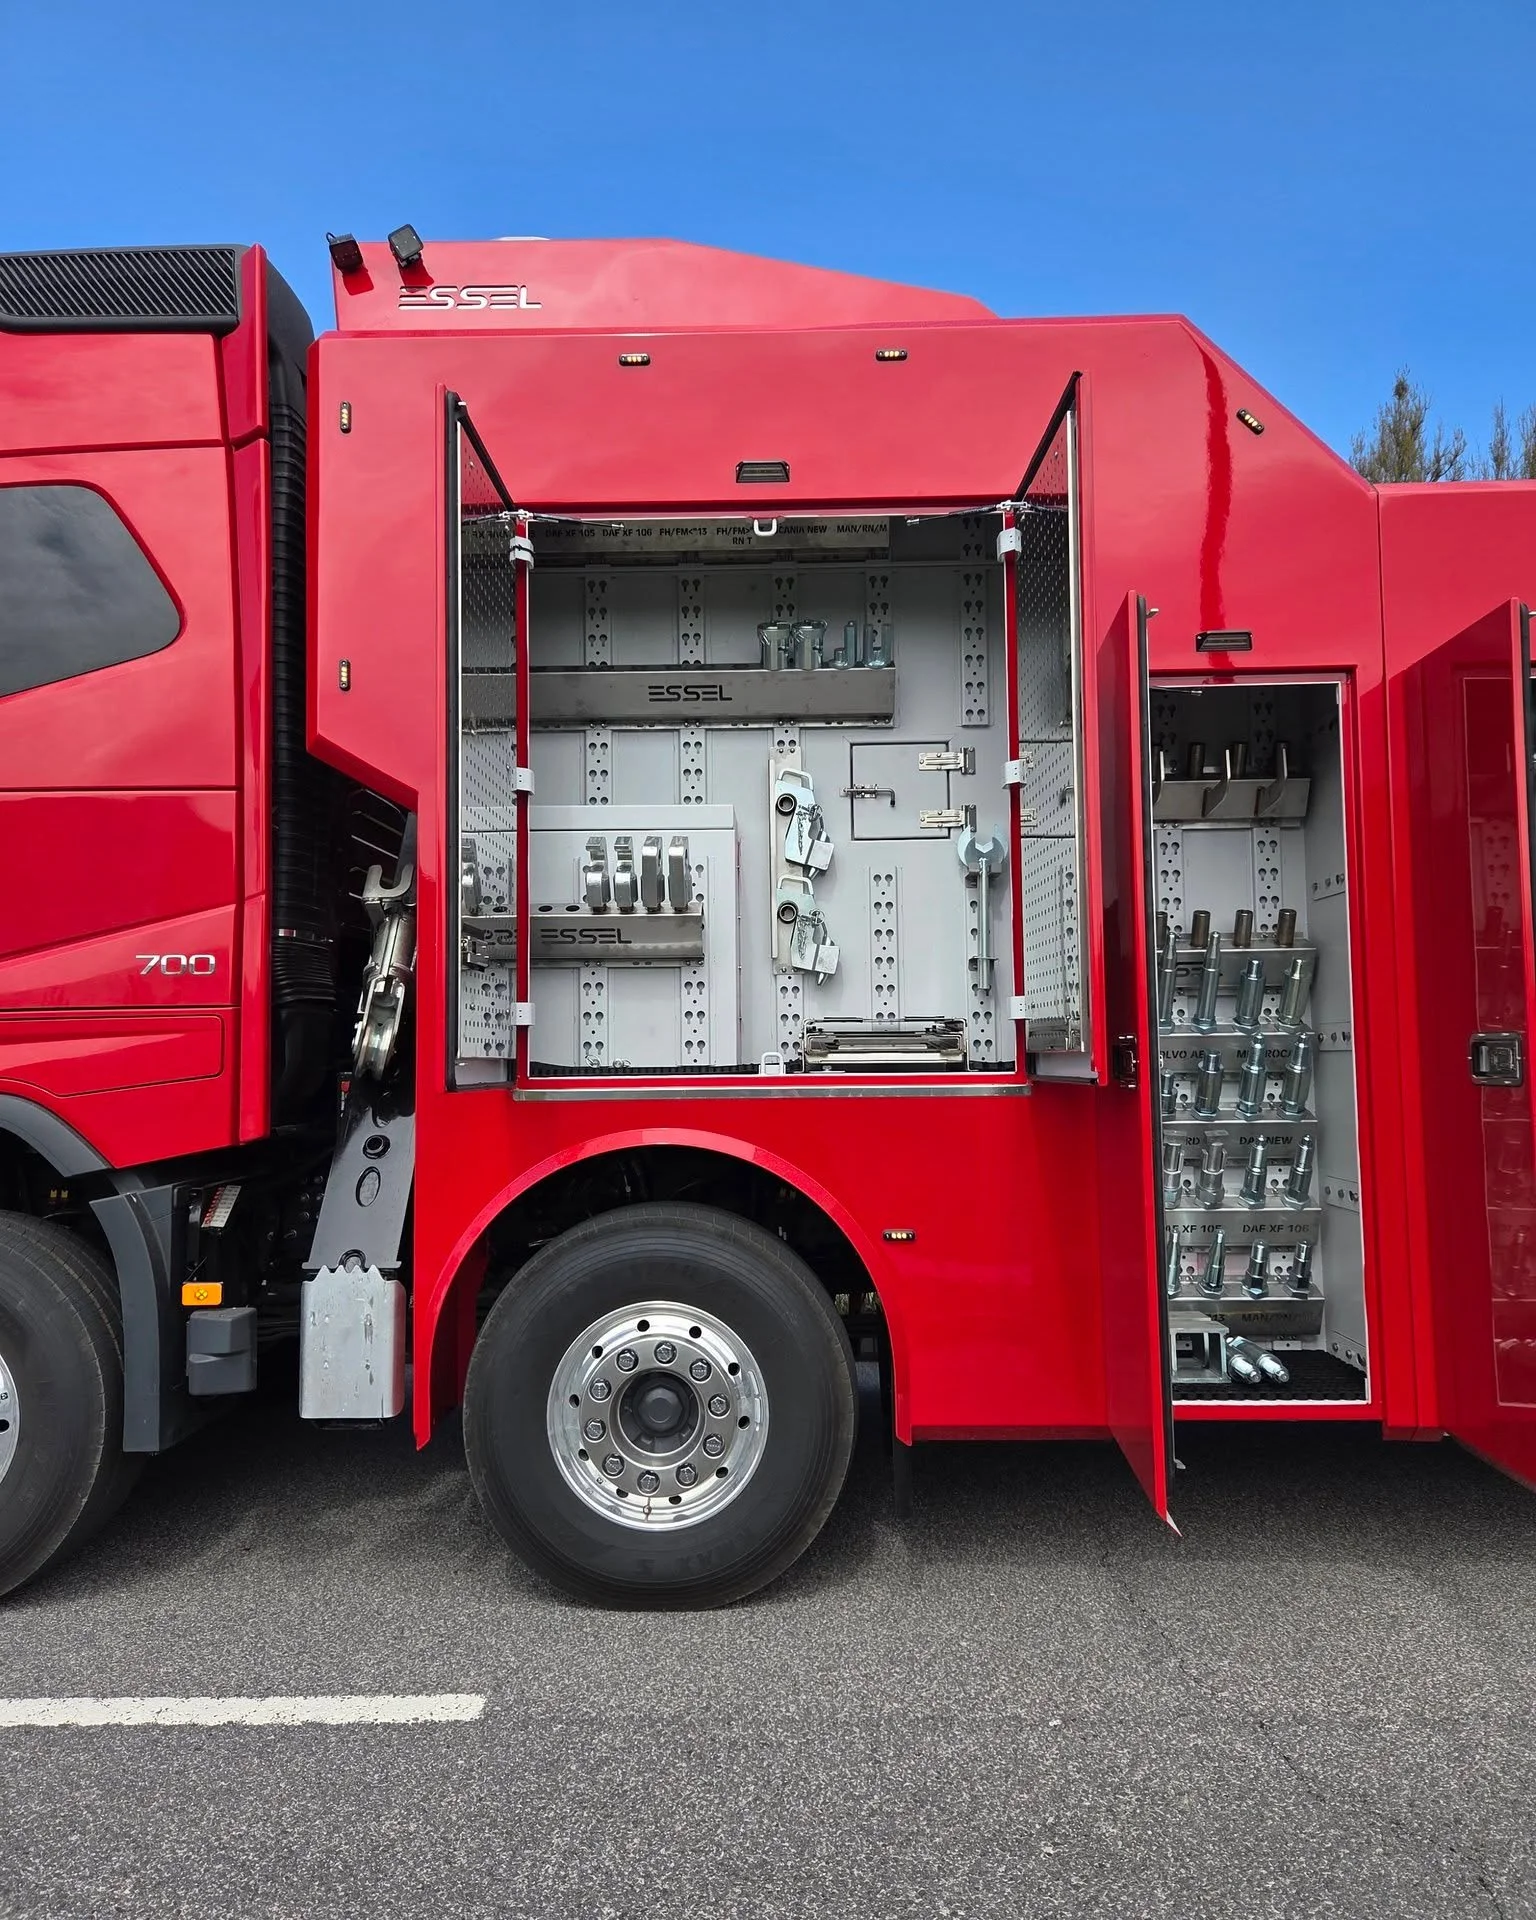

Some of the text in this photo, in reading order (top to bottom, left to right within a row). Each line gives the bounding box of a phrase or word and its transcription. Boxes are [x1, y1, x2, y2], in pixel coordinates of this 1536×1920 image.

[399, 285, 542, 310] ESSEL
[602, 528, 620, 537] DAF
[623, 528, 634, 537] XF
[807, 524, 828, 534] NEW
[732, 537, 753, 545] RN T
[648, 684, 733, 702] ESSEL
[540, 928, 633, 945] ESSEL
[135, 954, 216, 975] 700
[1266, 1136, 1294, 1145] NEW
[1182, 1224, 1197, 1234] XF
[1243, 1224, 1310, 1233] DAF XF 106
